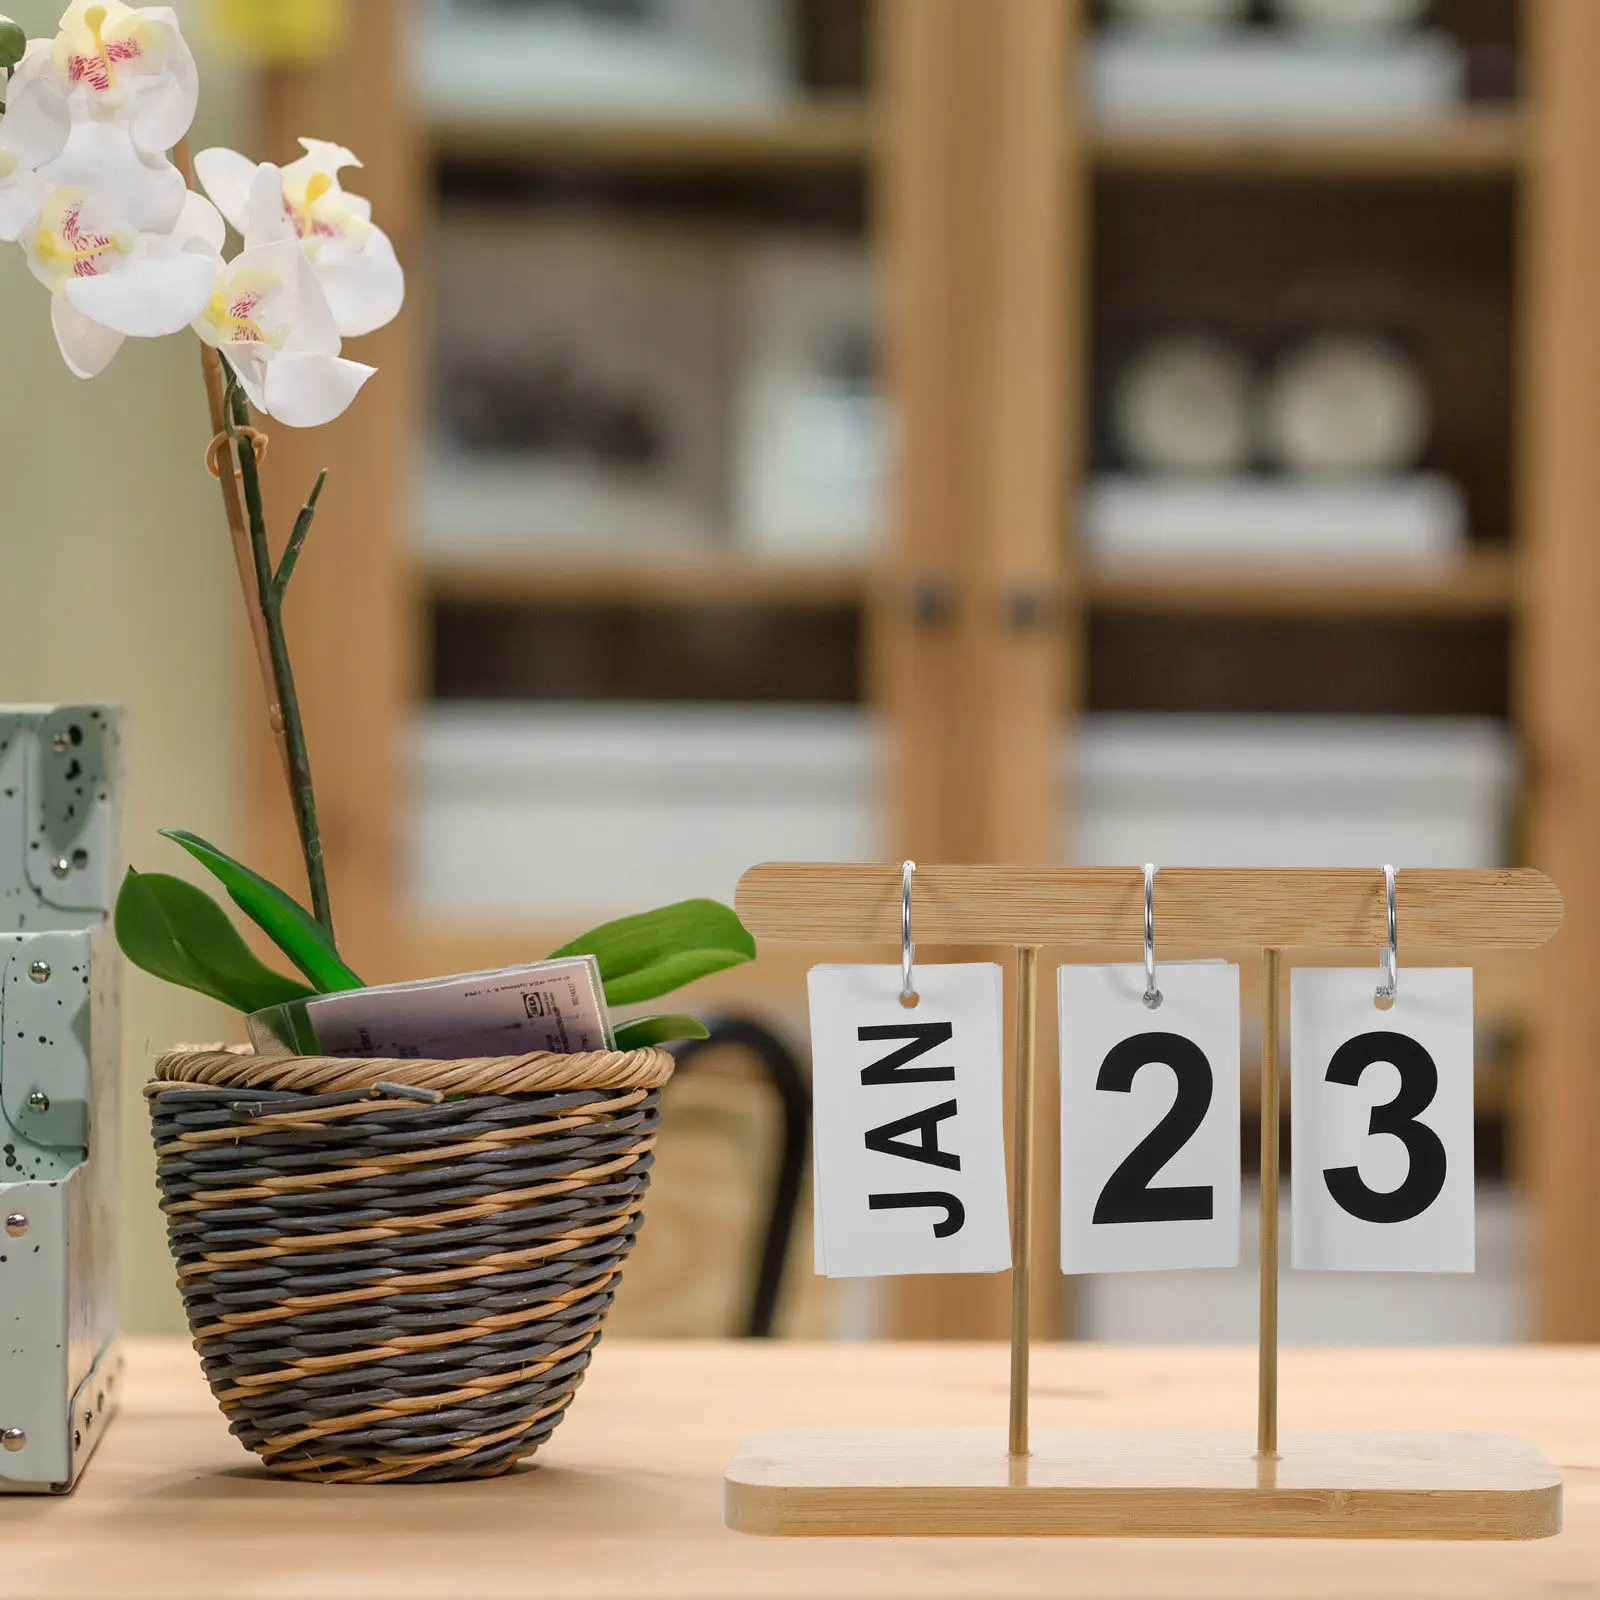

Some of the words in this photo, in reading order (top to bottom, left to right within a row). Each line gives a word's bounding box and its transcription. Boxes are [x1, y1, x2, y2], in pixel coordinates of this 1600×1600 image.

[858, 1022, 965, 1238] JAN
[1092, 1032, 1213, 1224] 2
[1323, 1031, 1446, 1223] 3
